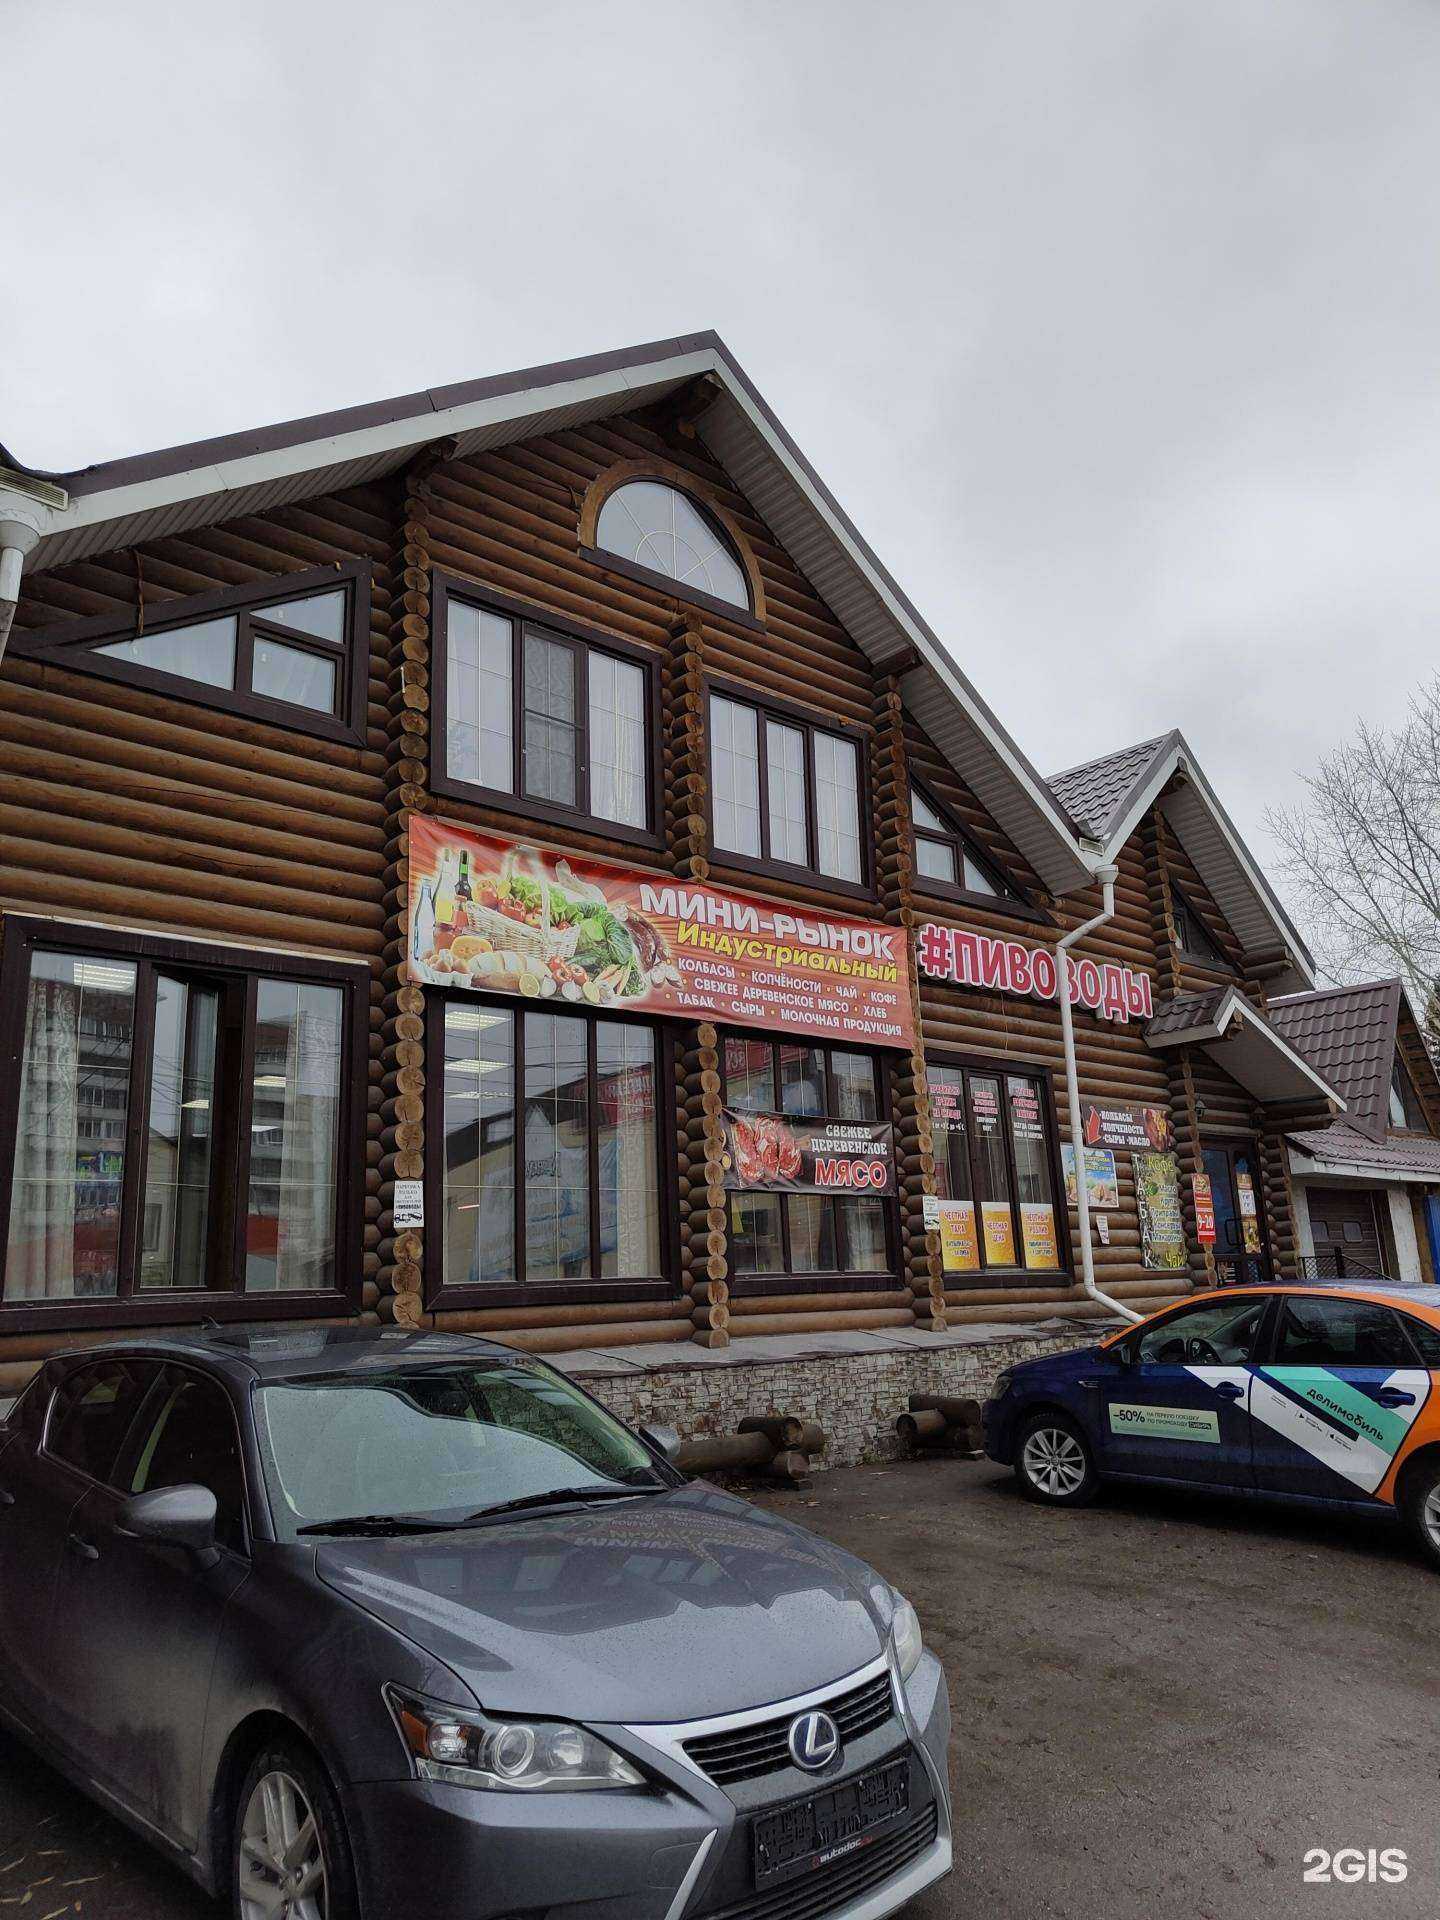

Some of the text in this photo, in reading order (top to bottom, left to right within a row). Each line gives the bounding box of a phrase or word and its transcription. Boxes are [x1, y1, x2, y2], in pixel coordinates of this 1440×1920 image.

[639, 883, 896, 961] МИНИ-РЫНОК
[677, 920, 897, 983] Индустриальный
[678, 957, 897, 1005] КОЛБАСЫ КОПЧЁНОСТИ ЧАЙ КОФЕ
[694, 977, 887, 1019] СВЕЖЕЕ ДЕРЕВЕНСКОЕ МЯСО ХЛЕБ
[677, 992, 902, 1037] ТАБАК СЫРЫ МОЛОЧНАЯ ПРОДУКЦИЯ
[825, 1124, 872, 1140] СВЕЖЕЕ
[1101, 1110, 1133, 1123] КОЛБАСЫ
[811, 1137, 888, 1155] ДЕРЕВЕНСКОЕ
[1105, 1134, 1125, 1144] СЫРЫ
[815, 1157, 887, 1189] МЯСО
[1306, 1388, 1384, 1441] делимобиль
